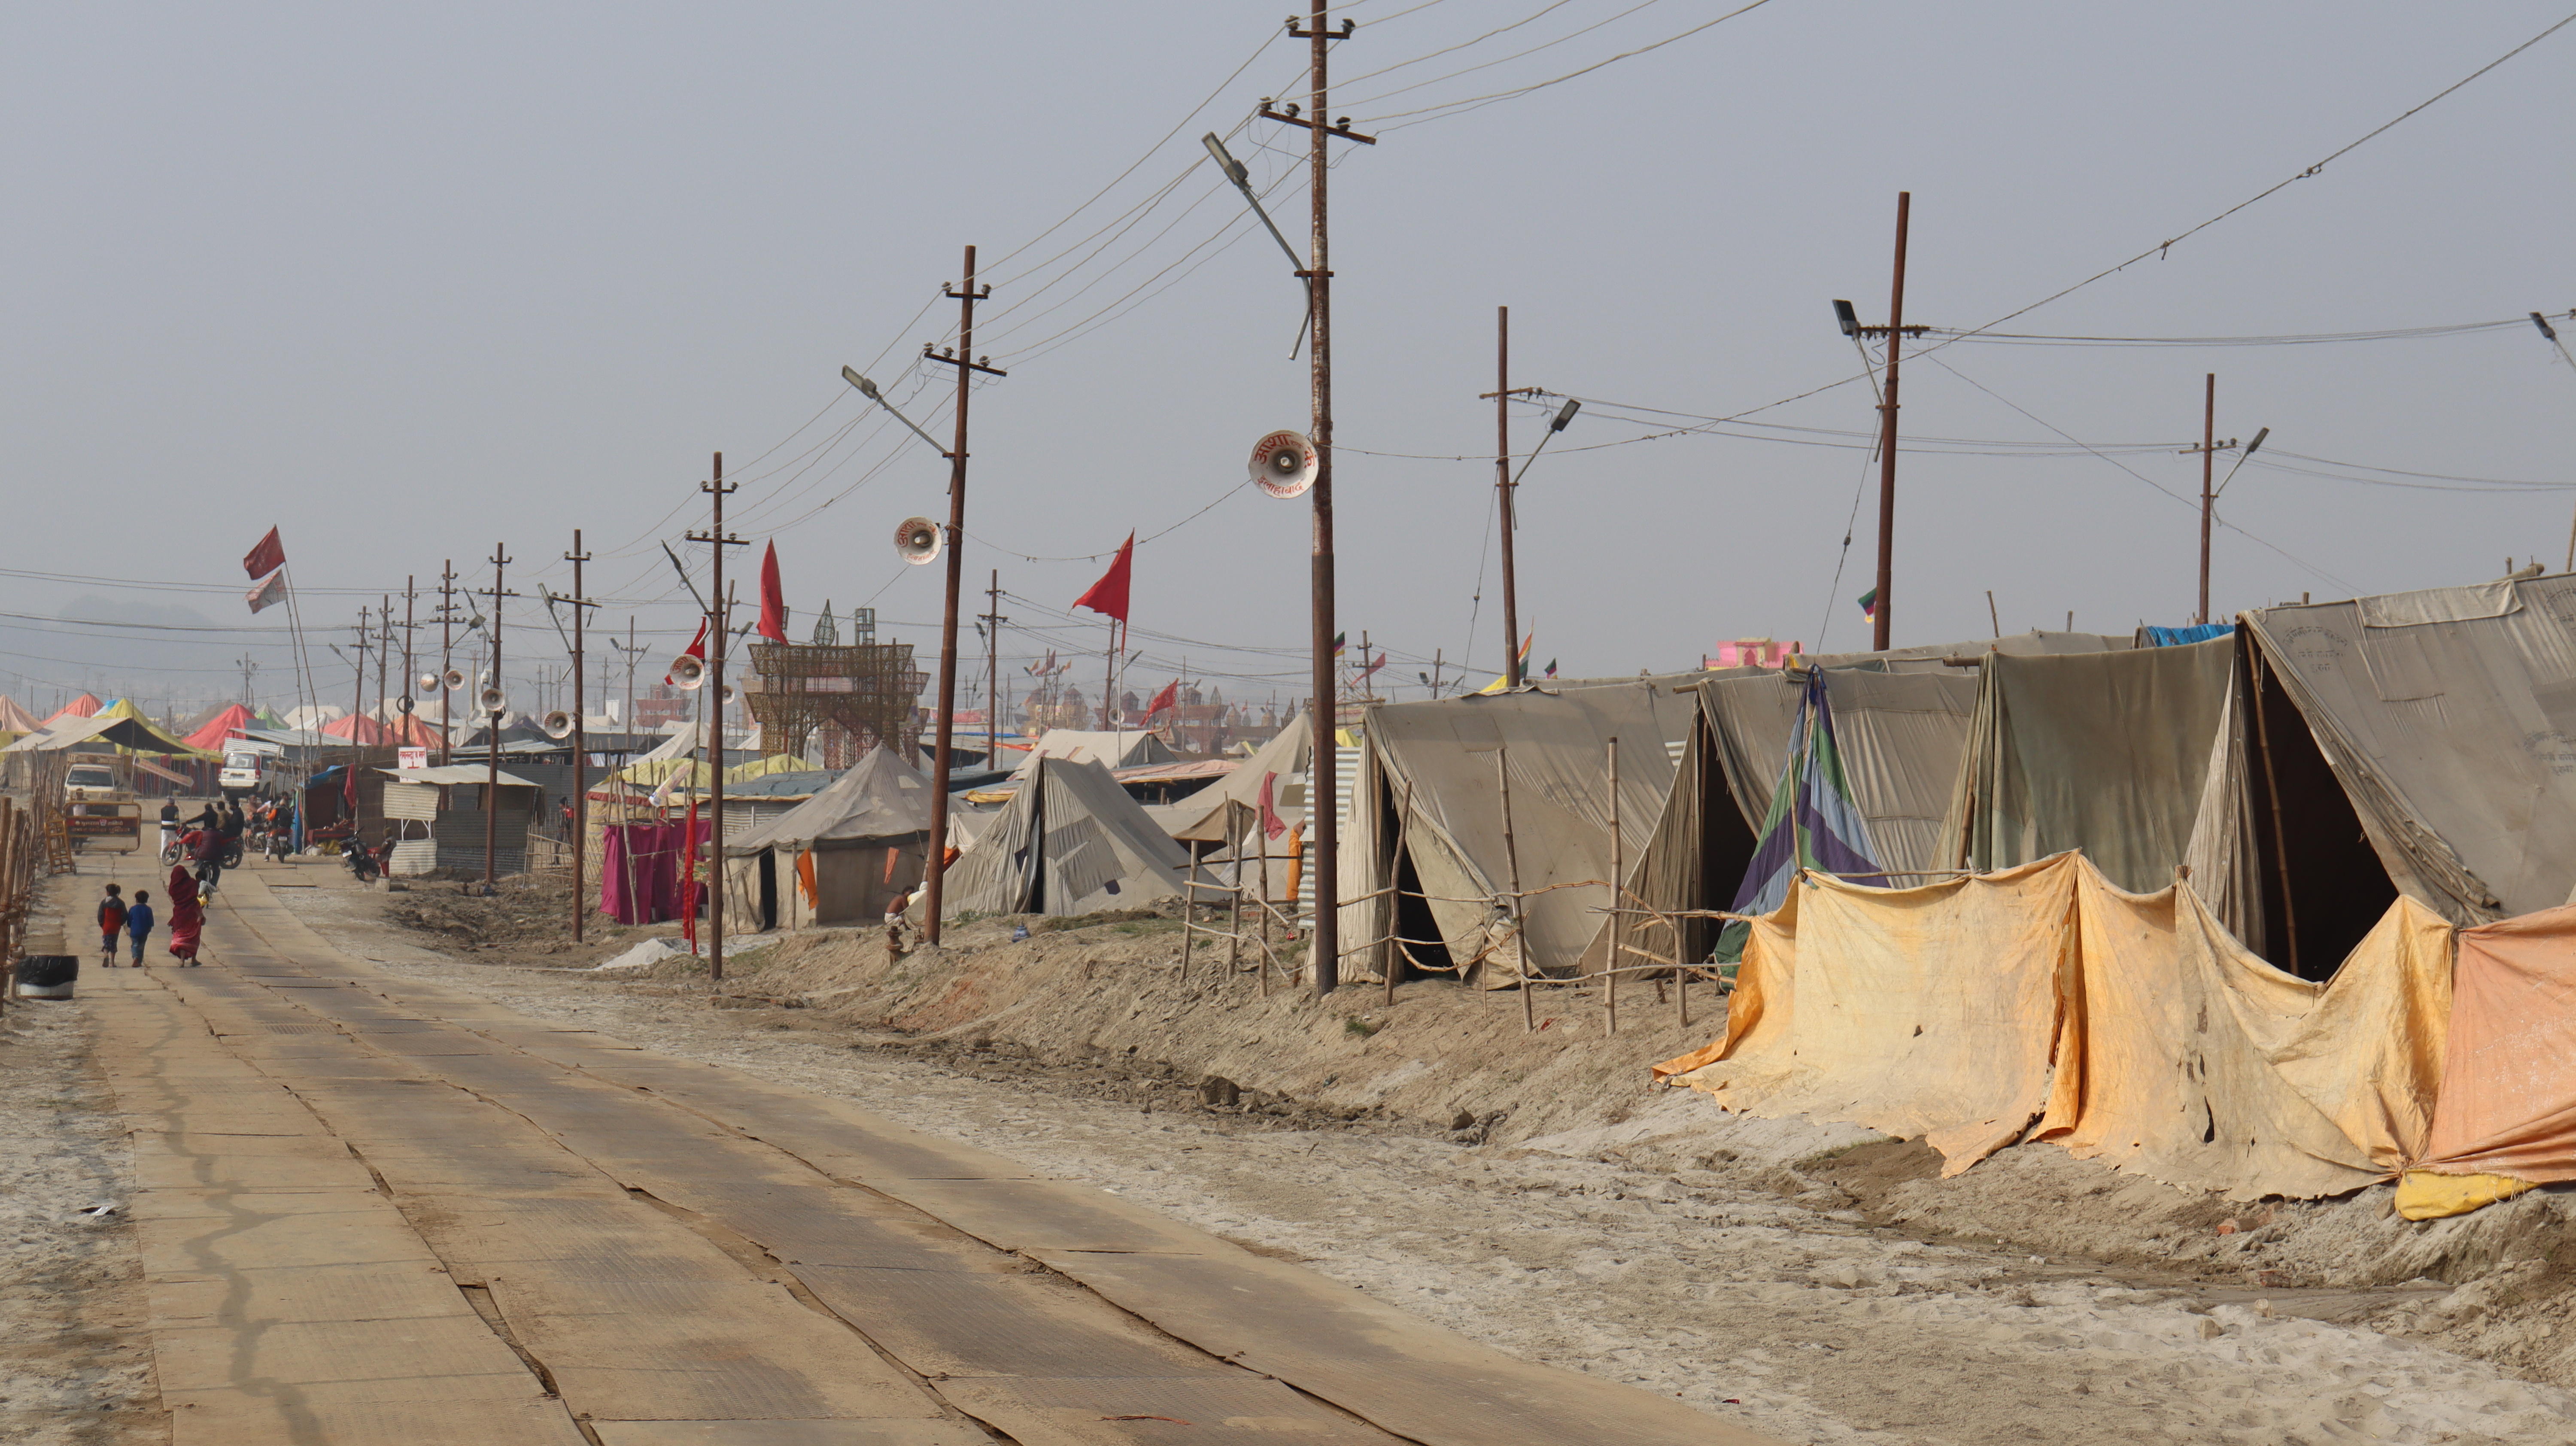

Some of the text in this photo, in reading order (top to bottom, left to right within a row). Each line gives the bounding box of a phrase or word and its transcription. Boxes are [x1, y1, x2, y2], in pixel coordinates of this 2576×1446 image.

[1254, 434, 1292, 464] आशा
[1257, 475, 1304, 496] इलाहाबाद
[897, 521, 917, 548] आशा
